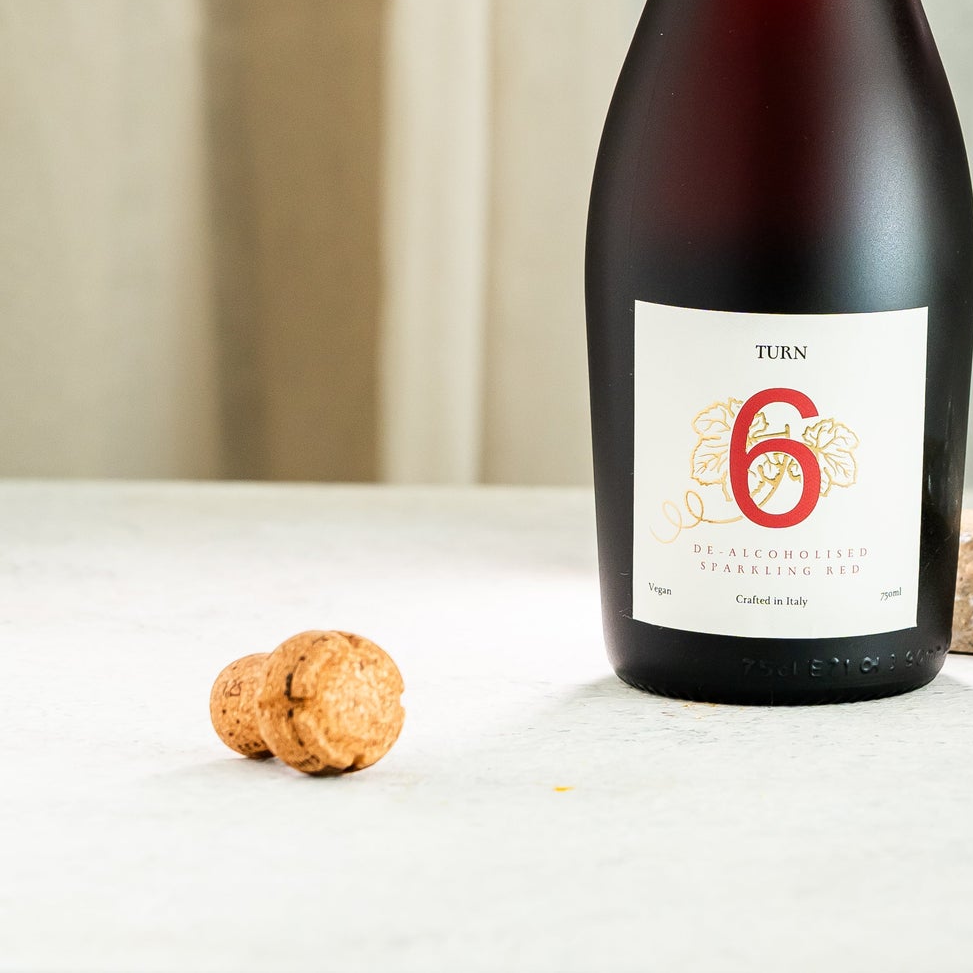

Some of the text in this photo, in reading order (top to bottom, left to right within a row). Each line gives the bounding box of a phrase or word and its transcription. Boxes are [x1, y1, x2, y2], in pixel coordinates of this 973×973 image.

[755, 344, 808, 361] TURN
[729, 387, 822, 530] 6
[693, 543, 868, 559] DE-ALCOHOLISED
[700, 561, 862, 576] SPARKLING RED
[648, 581, 673, 596] Vegan
[880, 586, 903, 602] 750ml
[735, 594, 809, 609] Crafted in Italy
